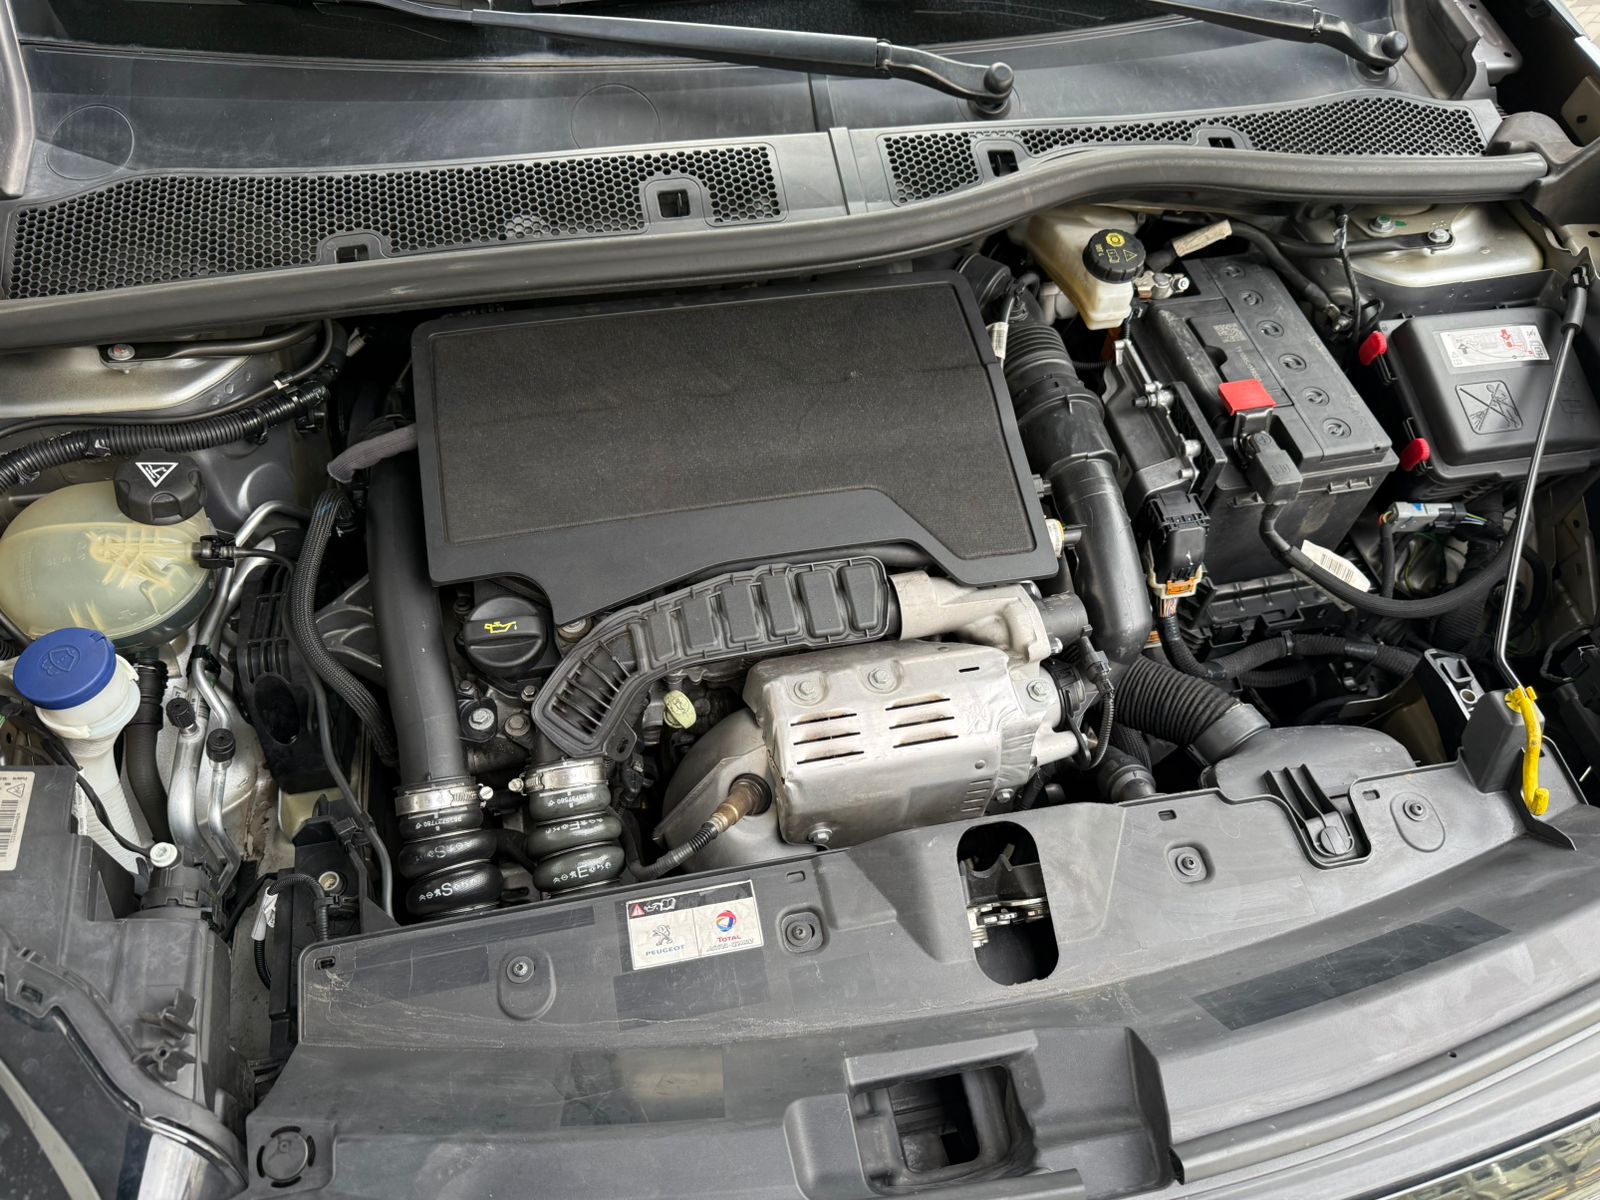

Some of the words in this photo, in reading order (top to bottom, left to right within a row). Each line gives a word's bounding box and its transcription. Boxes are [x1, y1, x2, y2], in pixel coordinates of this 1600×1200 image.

[441, 882, 453, 897] S
[716, 935, 741, 943] TOTAL
[645, 944, 685, 957] PEUGEOT
